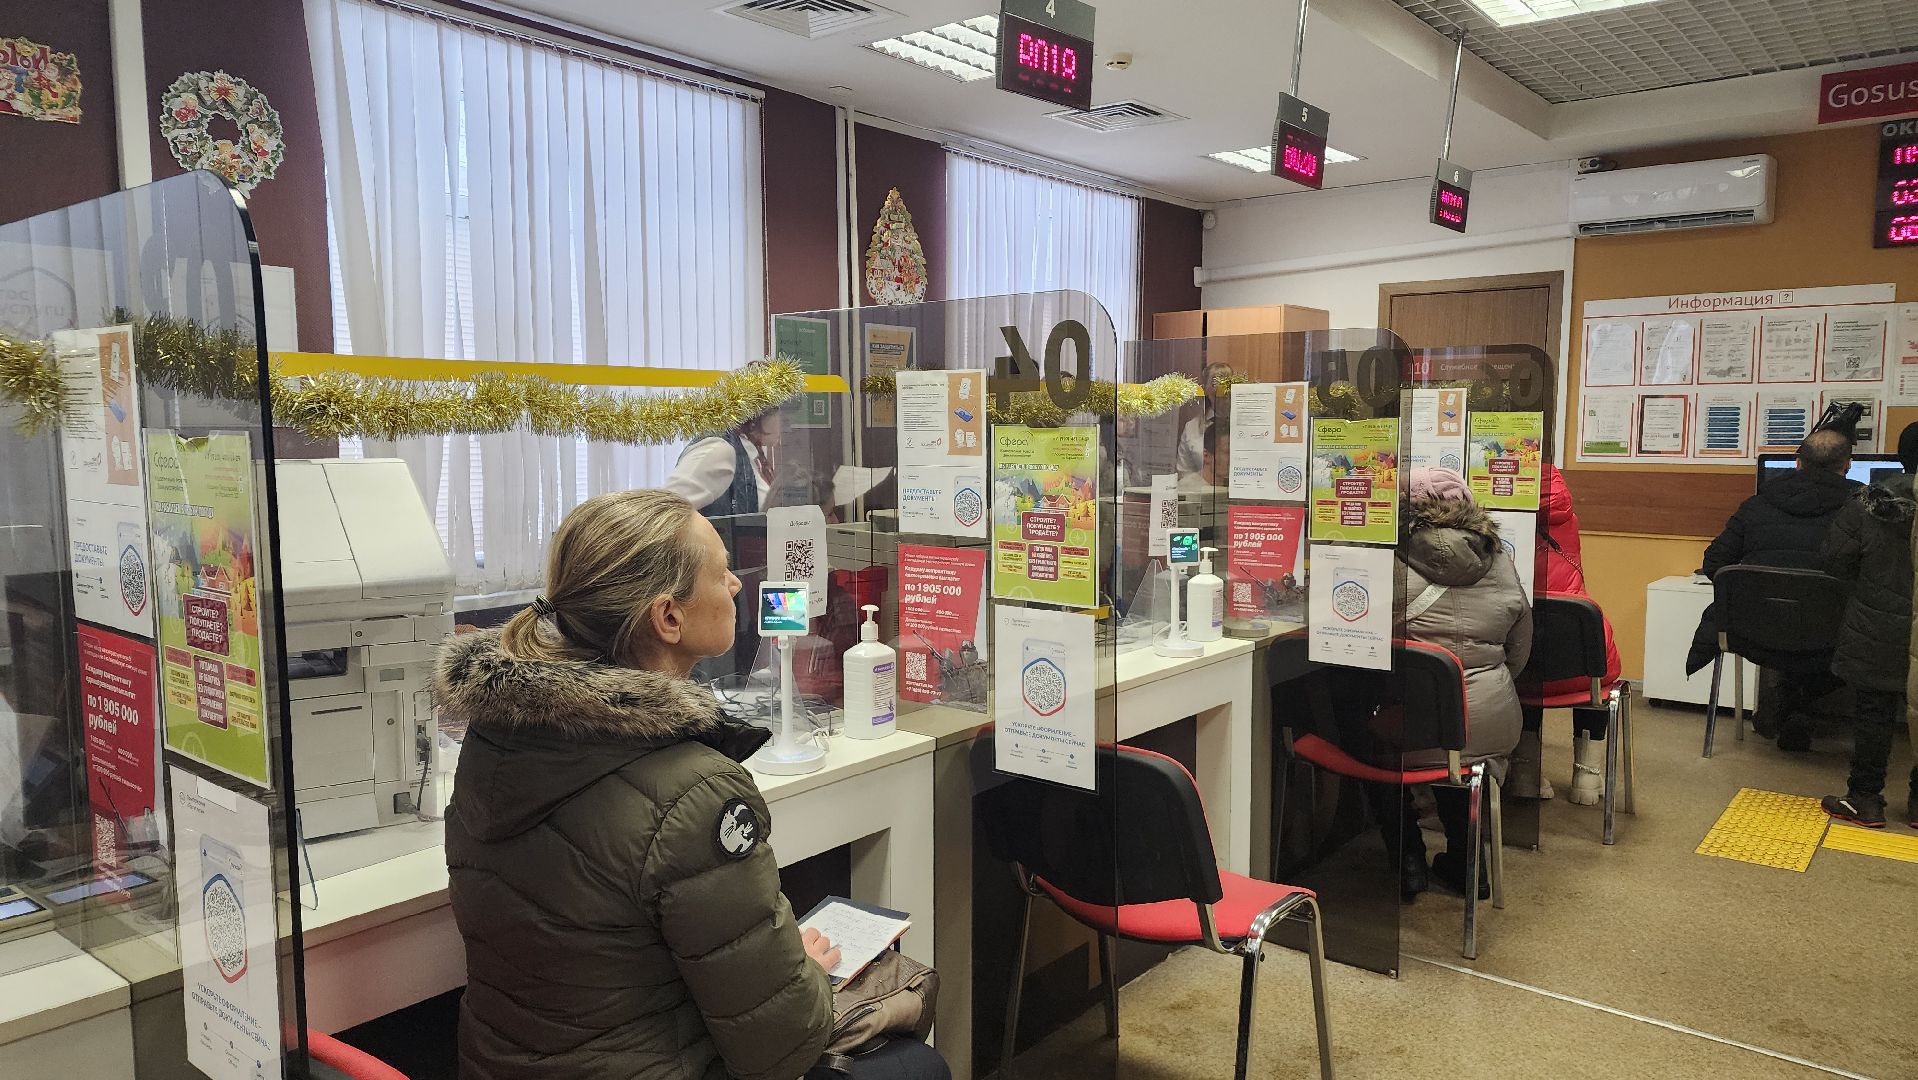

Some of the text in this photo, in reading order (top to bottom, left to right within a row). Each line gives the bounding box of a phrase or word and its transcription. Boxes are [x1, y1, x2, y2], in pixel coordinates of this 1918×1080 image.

[1045, 0, 1055, 19] 4
[1828, 80, 1918, 108] Gosus
[1301, 106, 1309, 122] 5
[1882, 121, 1918, 137] ОК
[1454, 170, 1459, 183] 6
[1668, 294, 1774, 311] Информация
[1318, 425, 1342, 434] Сфера
[1030, 516, 1057, 524] СТРОИТЕ?
[1233, 540, 1263, 549] рублей
[1249, 533, 1266, 541] 905
[1266, 533, 1284, 541] 000
[917, 583, 922, 591] 1
[922, 583, 941, 594] 905
[942, 585, 962, 597] 000
[904, 593, 938, 605] рублей
[191, 605, 219, 619] СТРОИТЕ?
[190, 616, 223, 632] ПОКУПАЕТЕ?
[87, 694, 139, 726] по 1 905 000
[88, 713, 117, 735] рублей
